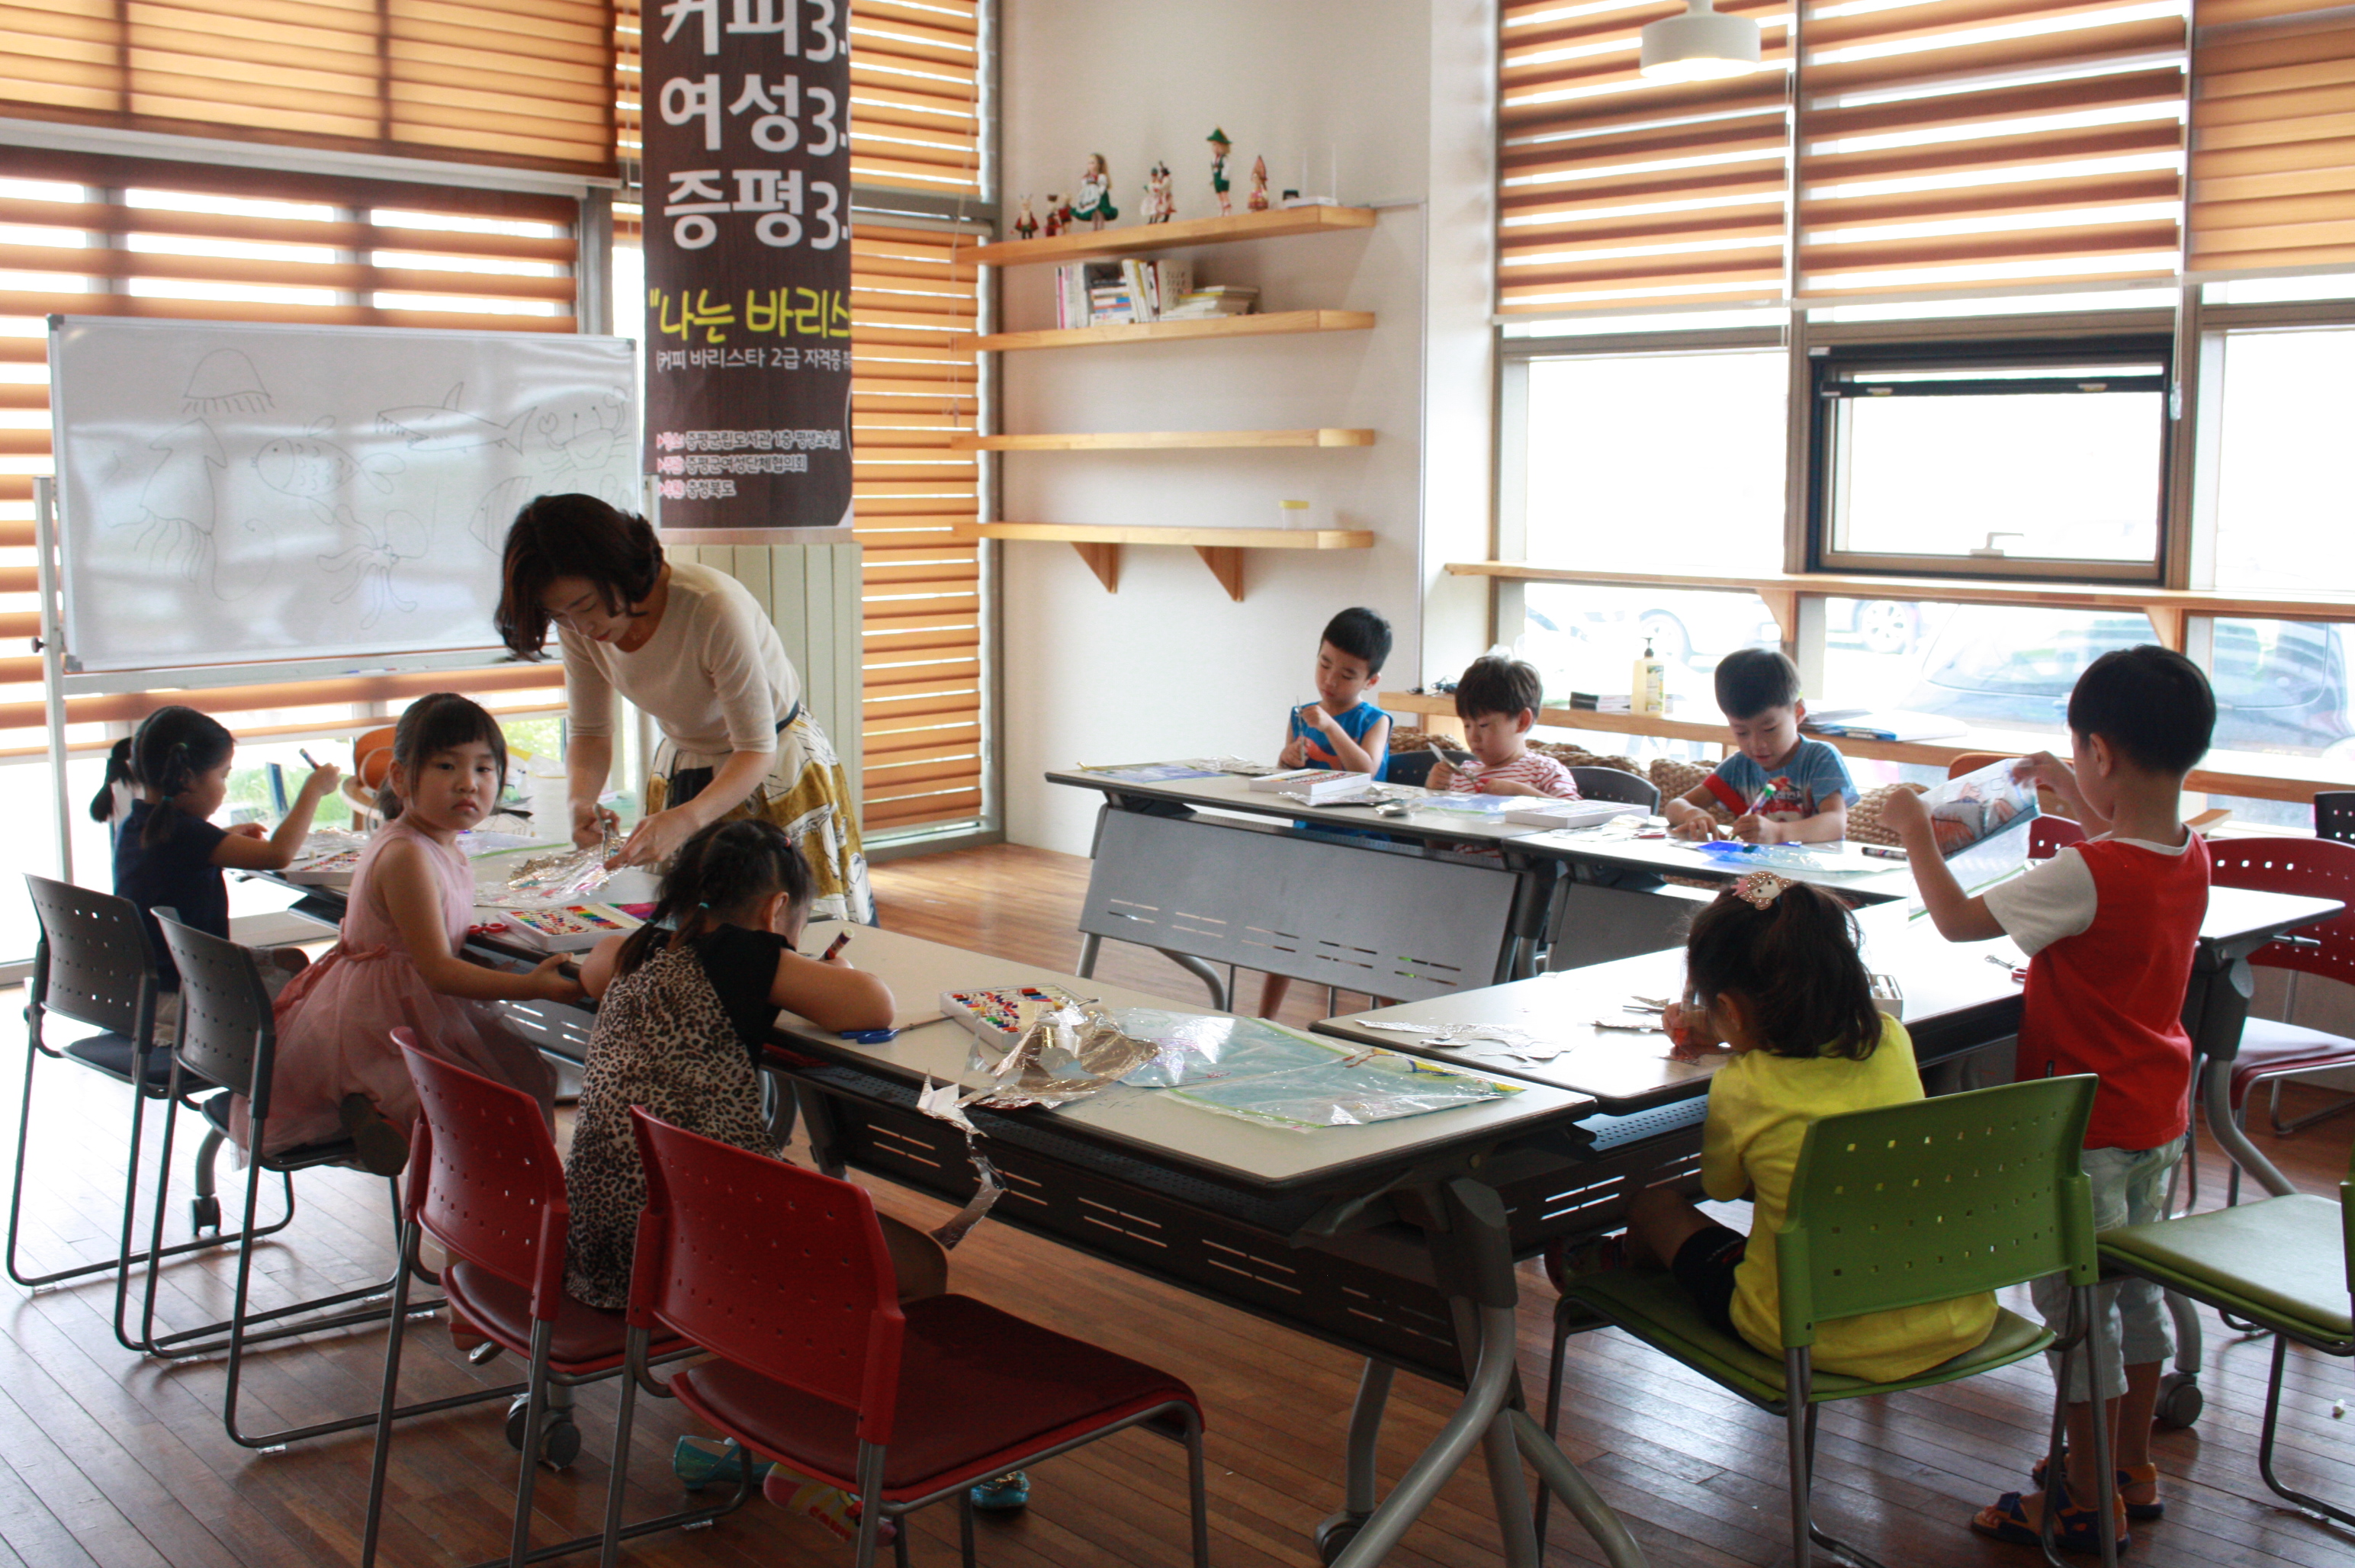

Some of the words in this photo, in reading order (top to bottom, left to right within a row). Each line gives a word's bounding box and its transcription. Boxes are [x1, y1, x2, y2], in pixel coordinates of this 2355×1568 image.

[660, 74, 851, 156] 여성3.
[664, 169, 852, 250] 증평3.
[746, 287, 851, 339] 바리스
[656, 349, 686, 373] (커피
[689, 348, 765, 369] 바리스타
[770, 347, 800, 370] 2급
[773, 429, 794, 450] 1층
[686, 478, 737, 500] 충청북도
